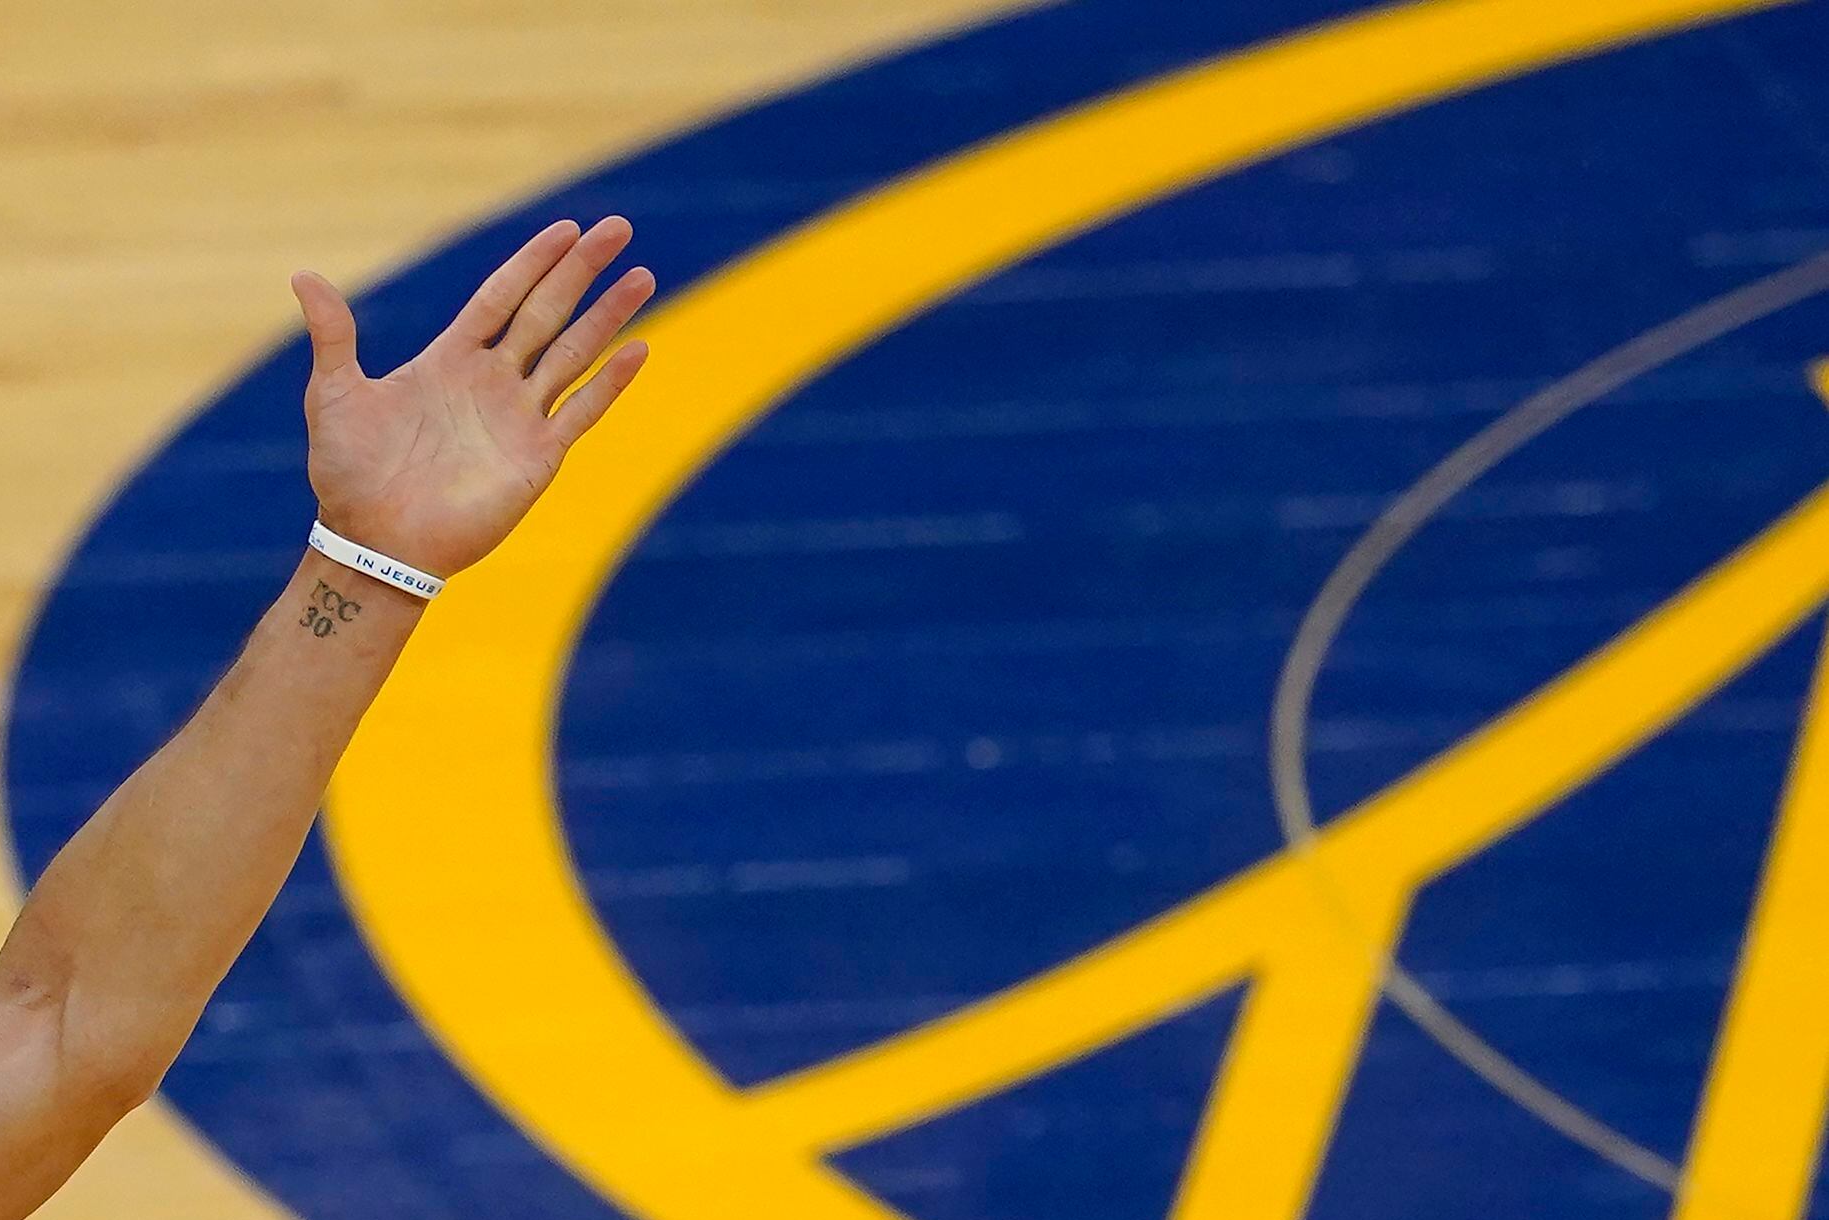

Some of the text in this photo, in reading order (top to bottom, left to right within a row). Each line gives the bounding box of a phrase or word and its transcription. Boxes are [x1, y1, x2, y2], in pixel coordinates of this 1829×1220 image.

[356, 553, 375, 569] IN
[380, 566, 436, 594] JESUS
[299, 604, 334, 638] 30
